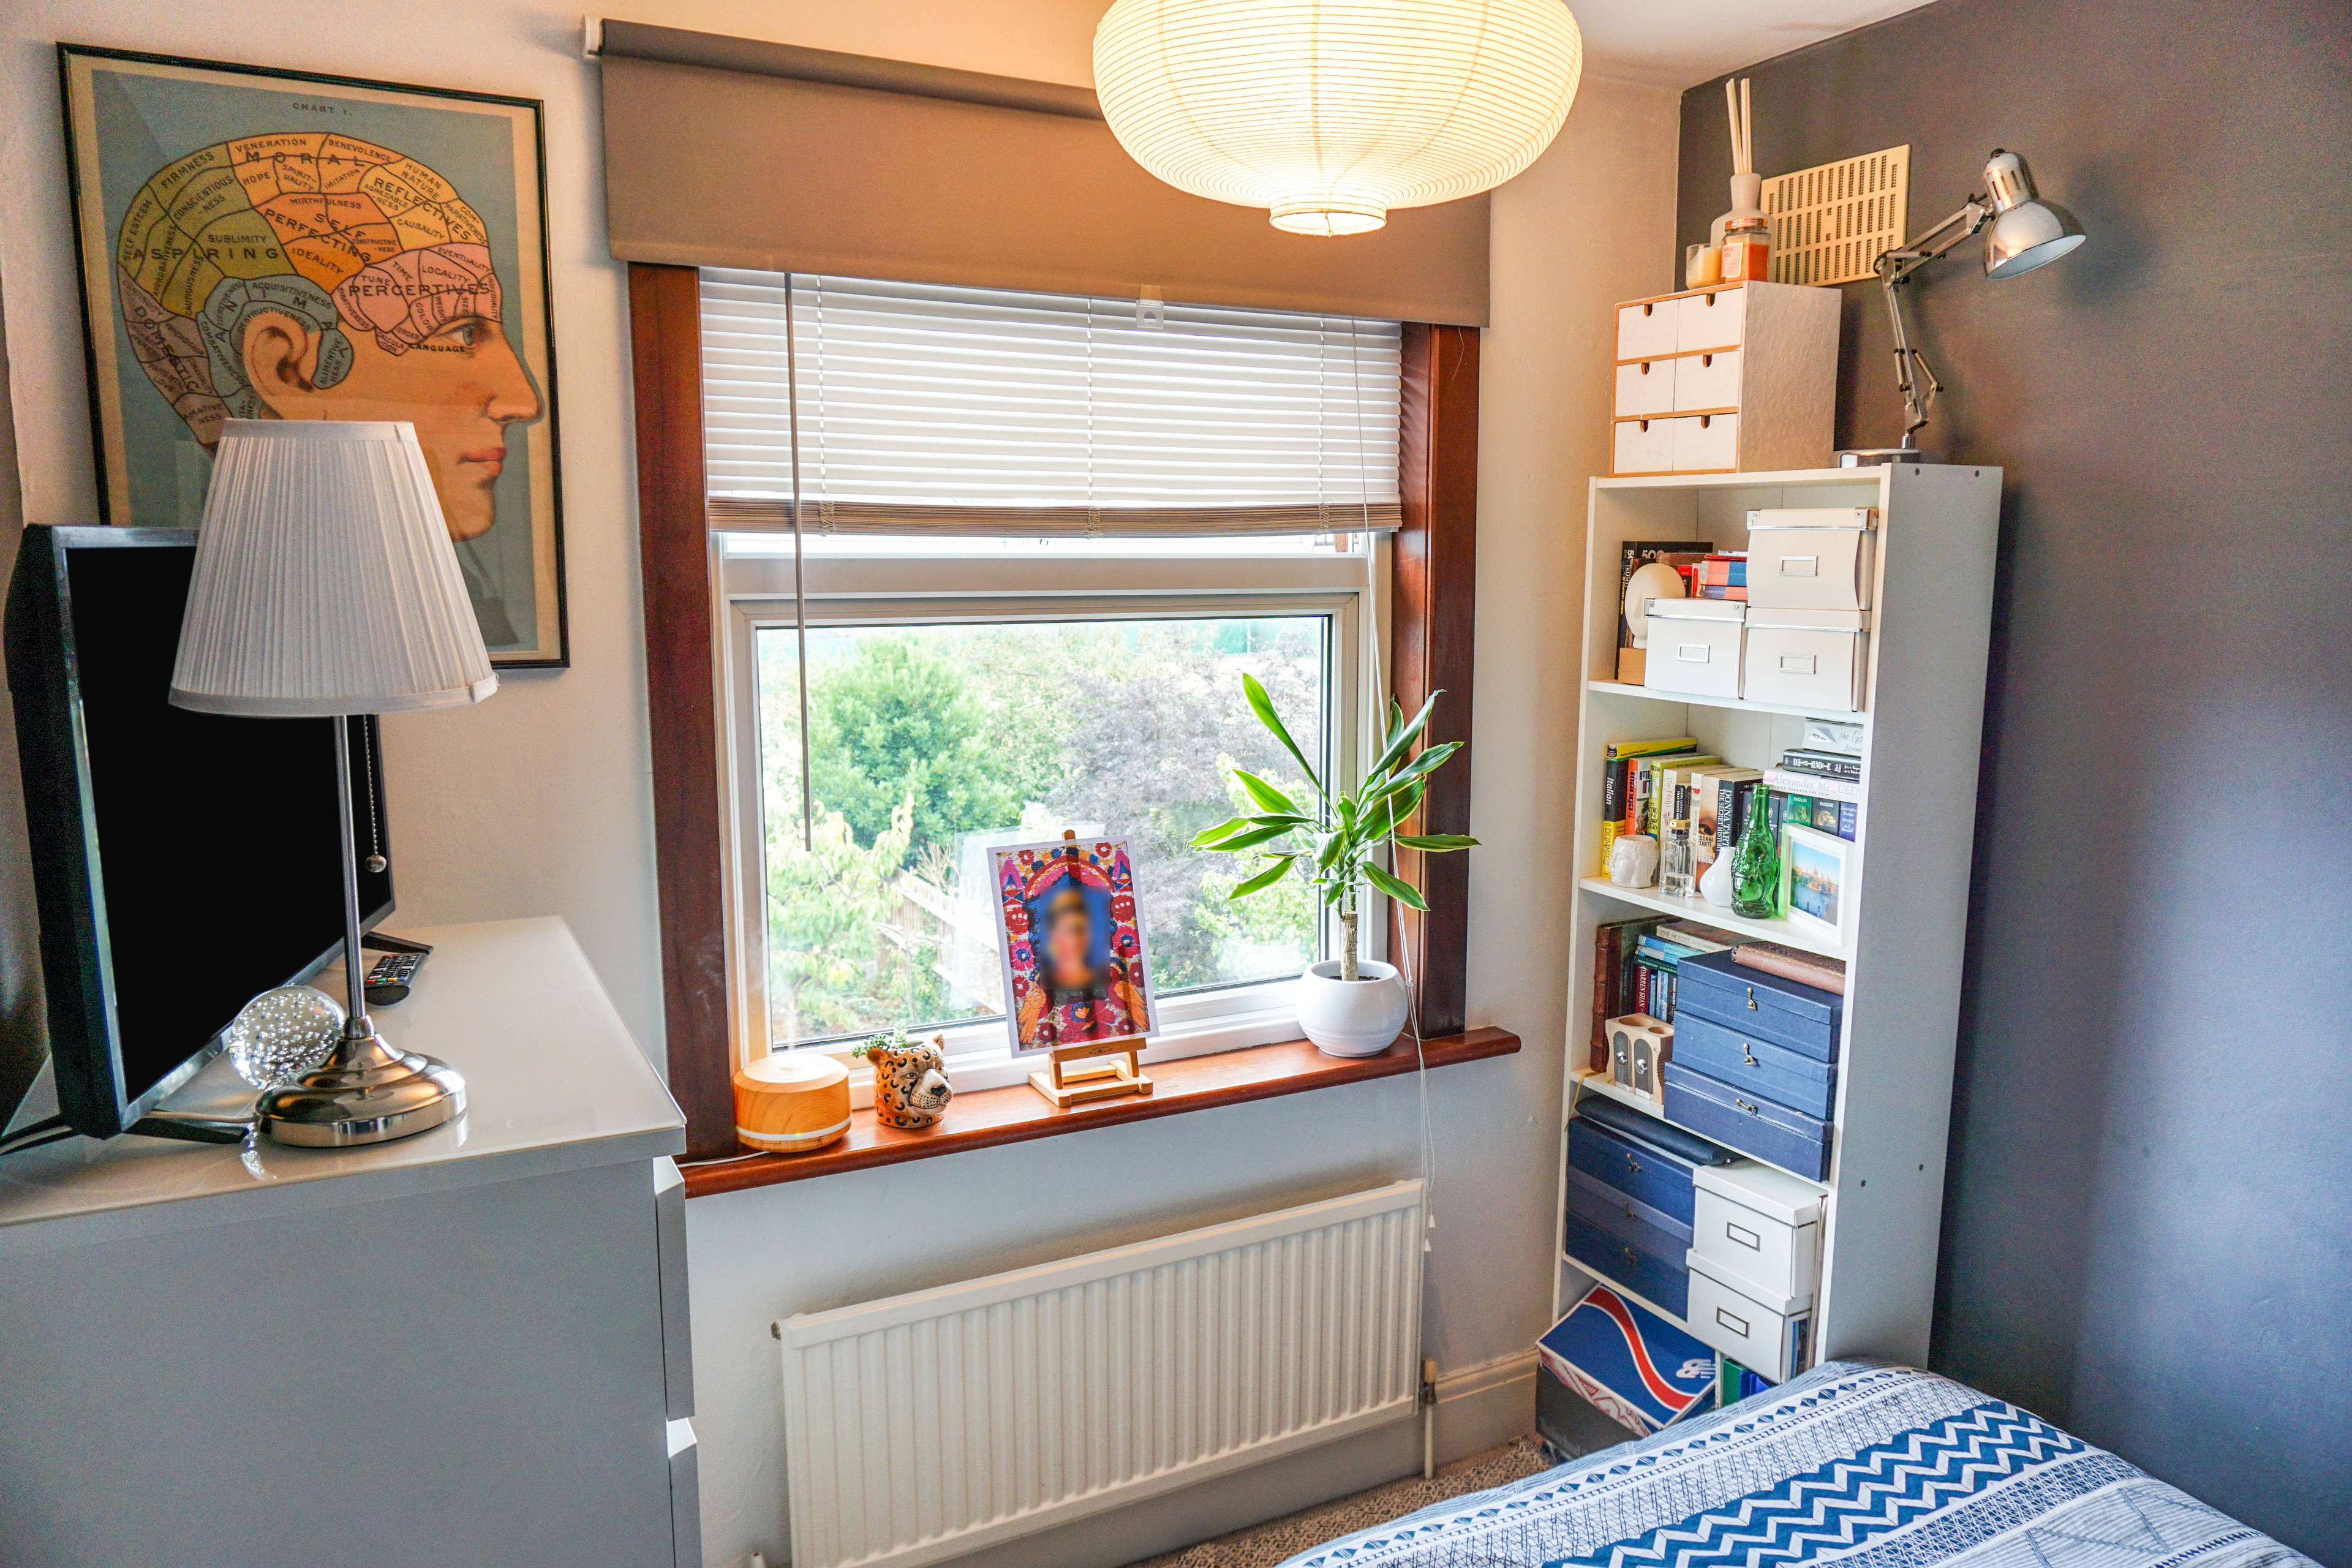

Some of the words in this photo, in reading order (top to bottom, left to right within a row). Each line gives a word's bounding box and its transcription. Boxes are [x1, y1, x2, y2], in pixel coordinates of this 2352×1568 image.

[293, 102, 335, 113] CHART
[235, 138, 307, 153] VENERATION
[328, 138, 391, 162] BENEVOLENCE
[160, 152, 214, 189] FIRMNESS
[242, 172, 271, 186] HOPE
[325, 168, 360, 189] IMITATION
[404, 162, 442, 189] HUMAN
[364, 184, 409, 208] AGREEABLE
[401, 171, 440, 200] NATURE
[289, 197, 362, 209] MIRTHFULNESS
[374, 177, 471, 240] REFLECTIVES
[130, 199, 153, 235] ESTEEM
[397, 219, 445, 239] CAUSALITY
[445, 203, 486, 244] PARATIVENESS
[208, 234, 266, 244] SUBLIMITY
[265, 208, 371, 262] PERFECTING
[132, 247, 278, 260] ASPIRING
[292, 247, 344, 273] IDEALITY
[437, 247, 491, 273] EVENTUALITY
[361, 275, 391, 287] TUNE
[392, 261, 413, 282] TIME
[422, 266, 470, 282] LOCALITY
[186, 255, 204, 315] CAUTIOUSNESS
[252, 282, 332, 309] ACQUISITIVENESS
[349, 283, 490, 297] PERCEPTIVES
[416, 302, 433, 330] COLOR
[435, 295, 447, 322] WEIGHT
[397, 327, 420, 341] ORDER
[410, 344, 466, 353] LANGUAGE
[1605, 777, 1615, 805] Italian
[1773, 774, 1813, 789] Alexander
[1723, 789, 1732, 822] DONNA
[1602, 827, 1611, 866] DUMMIES
[1722, 823, 1730, 847] TART
